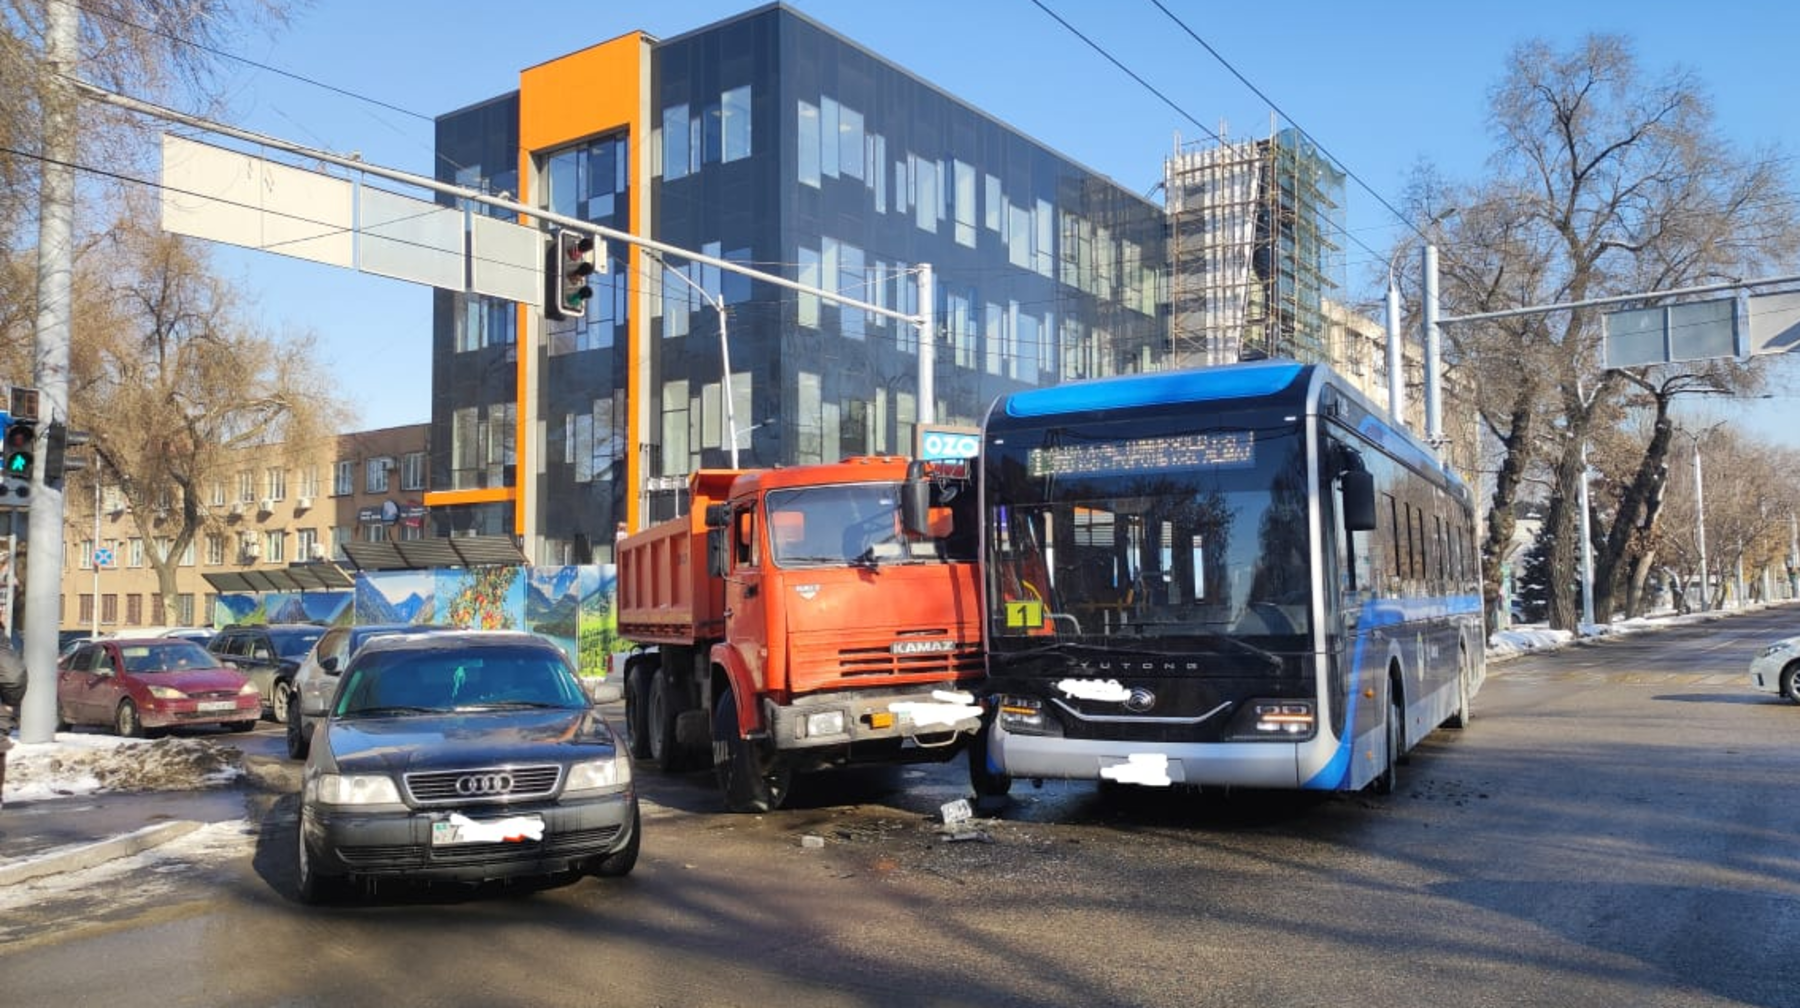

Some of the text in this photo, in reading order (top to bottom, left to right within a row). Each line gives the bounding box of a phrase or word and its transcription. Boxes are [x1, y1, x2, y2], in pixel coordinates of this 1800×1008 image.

[1017, 605, 1028, 626] 1
[893, 641, 953, 653] KAMAZ
[1079, 661, 1199, 670] YUTONG
